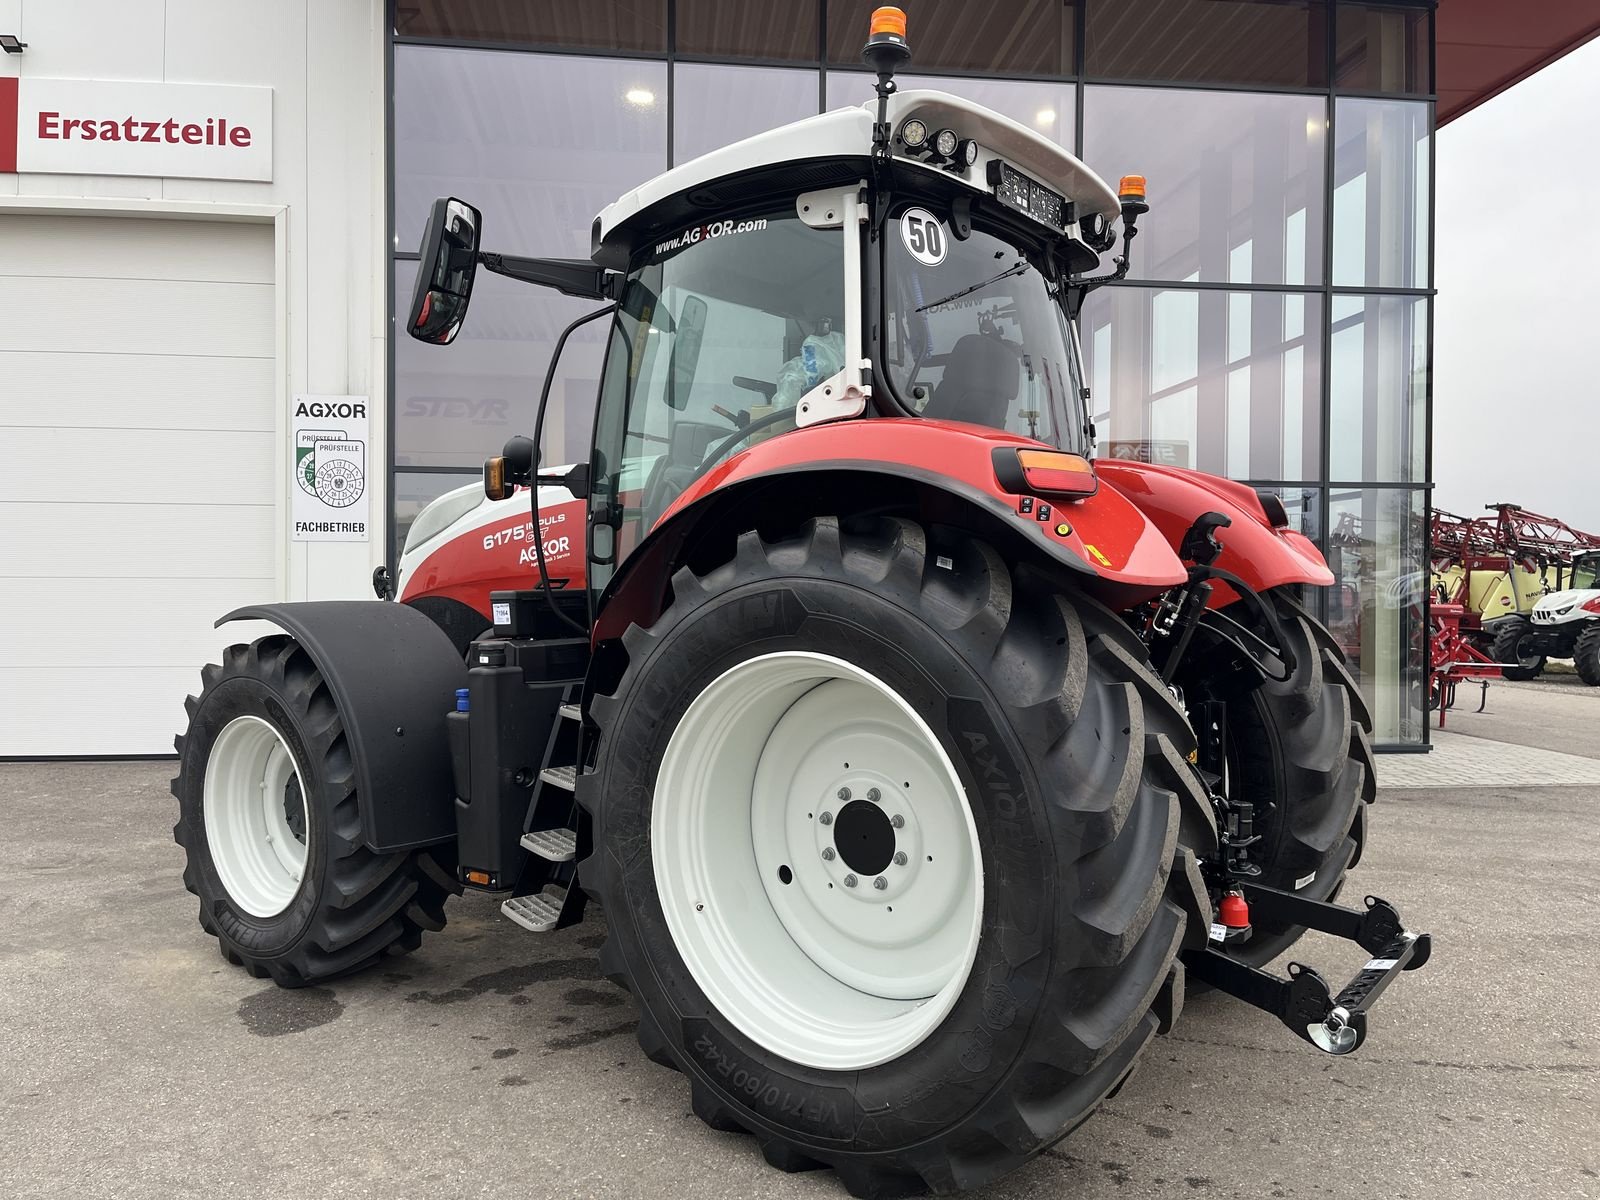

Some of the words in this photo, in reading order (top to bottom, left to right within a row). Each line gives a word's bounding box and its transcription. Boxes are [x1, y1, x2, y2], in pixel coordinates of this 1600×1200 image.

[37, 111, 252, 147] Ersatzteile
[655, 219, 768, 255] www.AGXOR.com
[908, 215, 942, 257] 50
[295, 402, 366, 419] AGXOR
[319, 444, 360, 452] PRÜFSTELLE
[296, 521, 365, 533] FACHBETRIEB
[483, 525, 525, 550] 6175
[525, 527, 549, 543] CT
